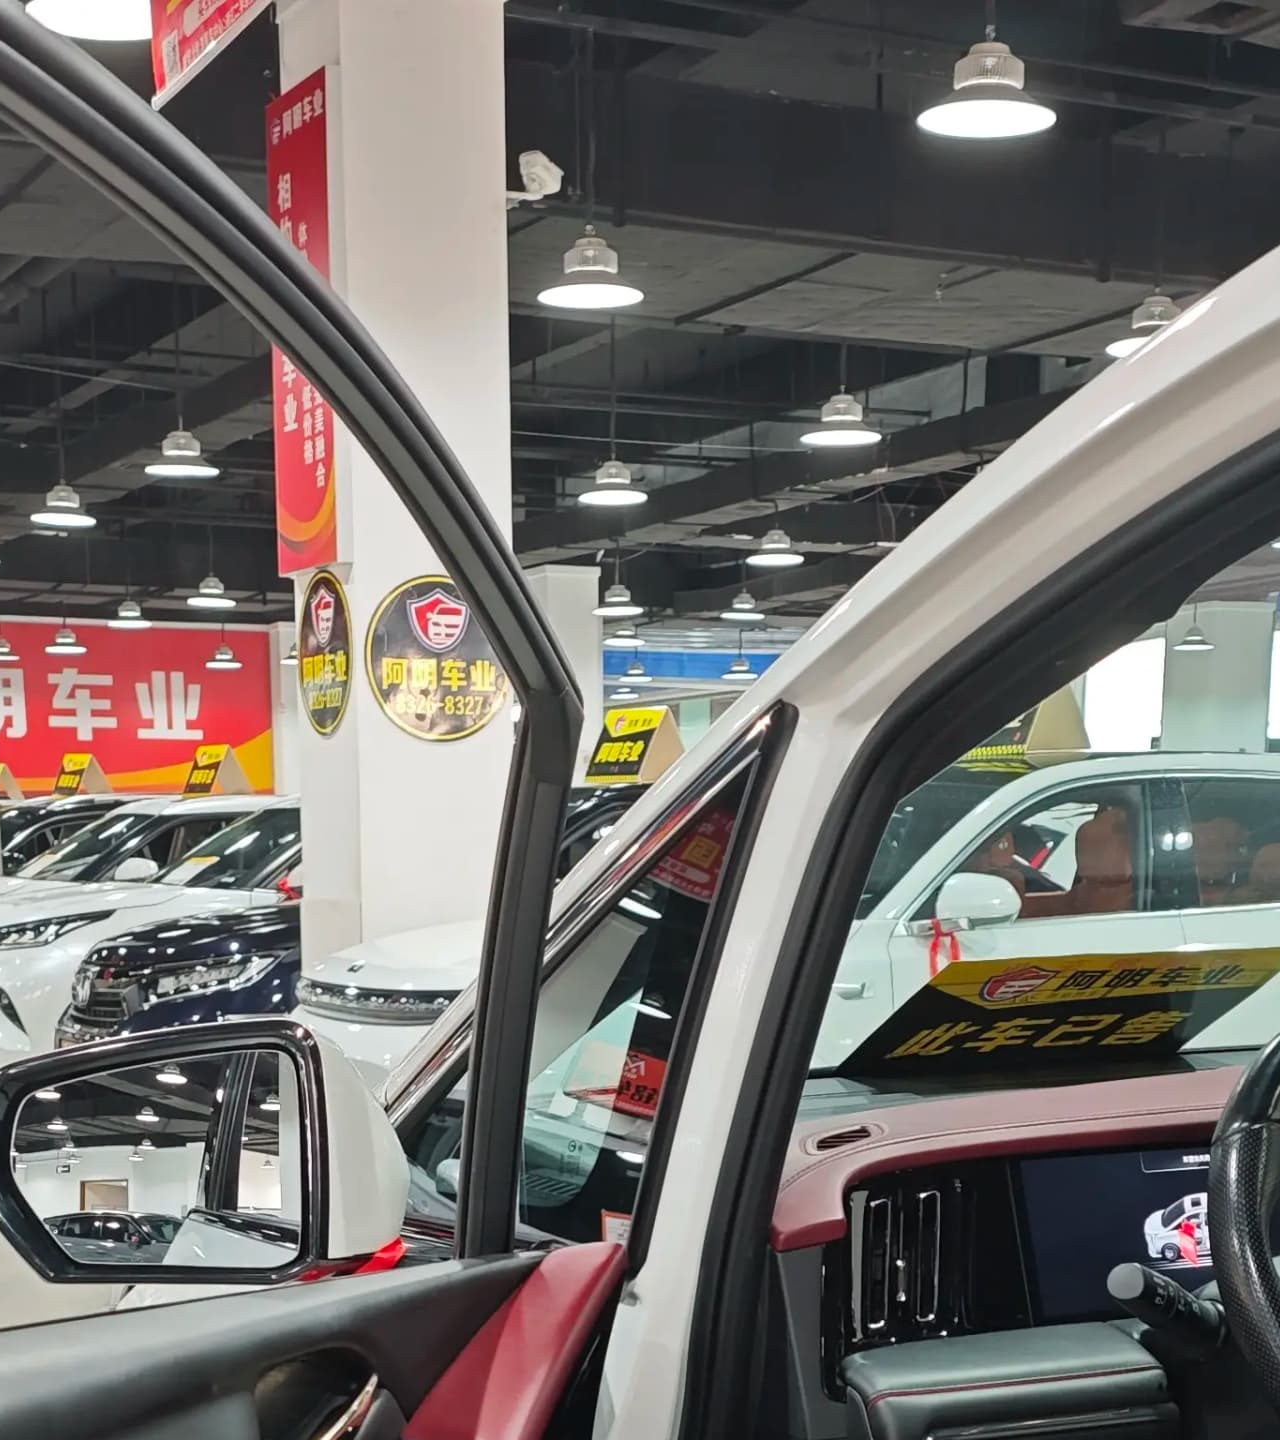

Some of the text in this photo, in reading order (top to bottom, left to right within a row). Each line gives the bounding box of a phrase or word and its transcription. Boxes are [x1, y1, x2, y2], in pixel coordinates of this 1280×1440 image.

[303, 650, 347, 688] 阿明车业
[382, 657, 496, 692] 阿明车业
[394, 694, 485, 715] 8326-8327
[1055, 965, 1245, 992] 阿明车业
[884, 1011, 1193, 1060] 此车已售
